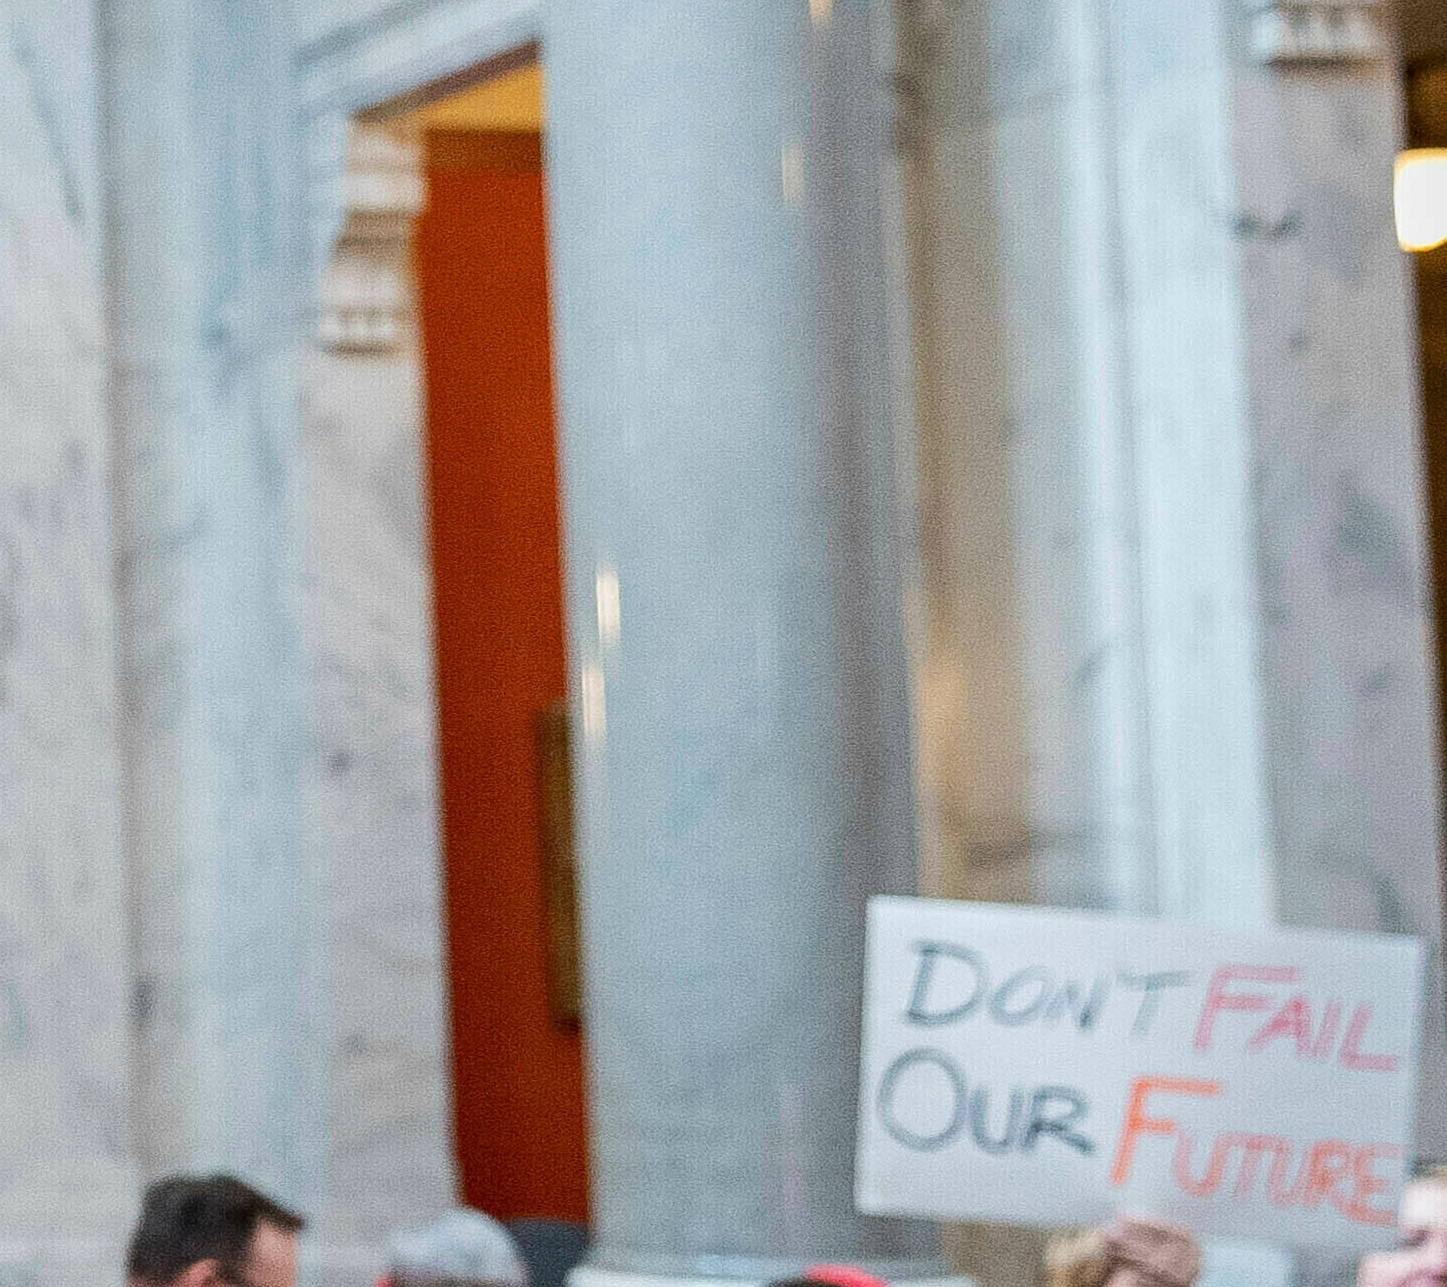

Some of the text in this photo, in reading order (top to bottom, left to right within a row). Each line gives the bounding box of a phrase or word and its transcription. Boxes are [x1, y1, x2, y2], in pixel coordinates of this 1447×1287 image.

[1195, 963, 1398, 1072] FAIL
[877, 1046, 1405, 1227] OUR FUTURE
